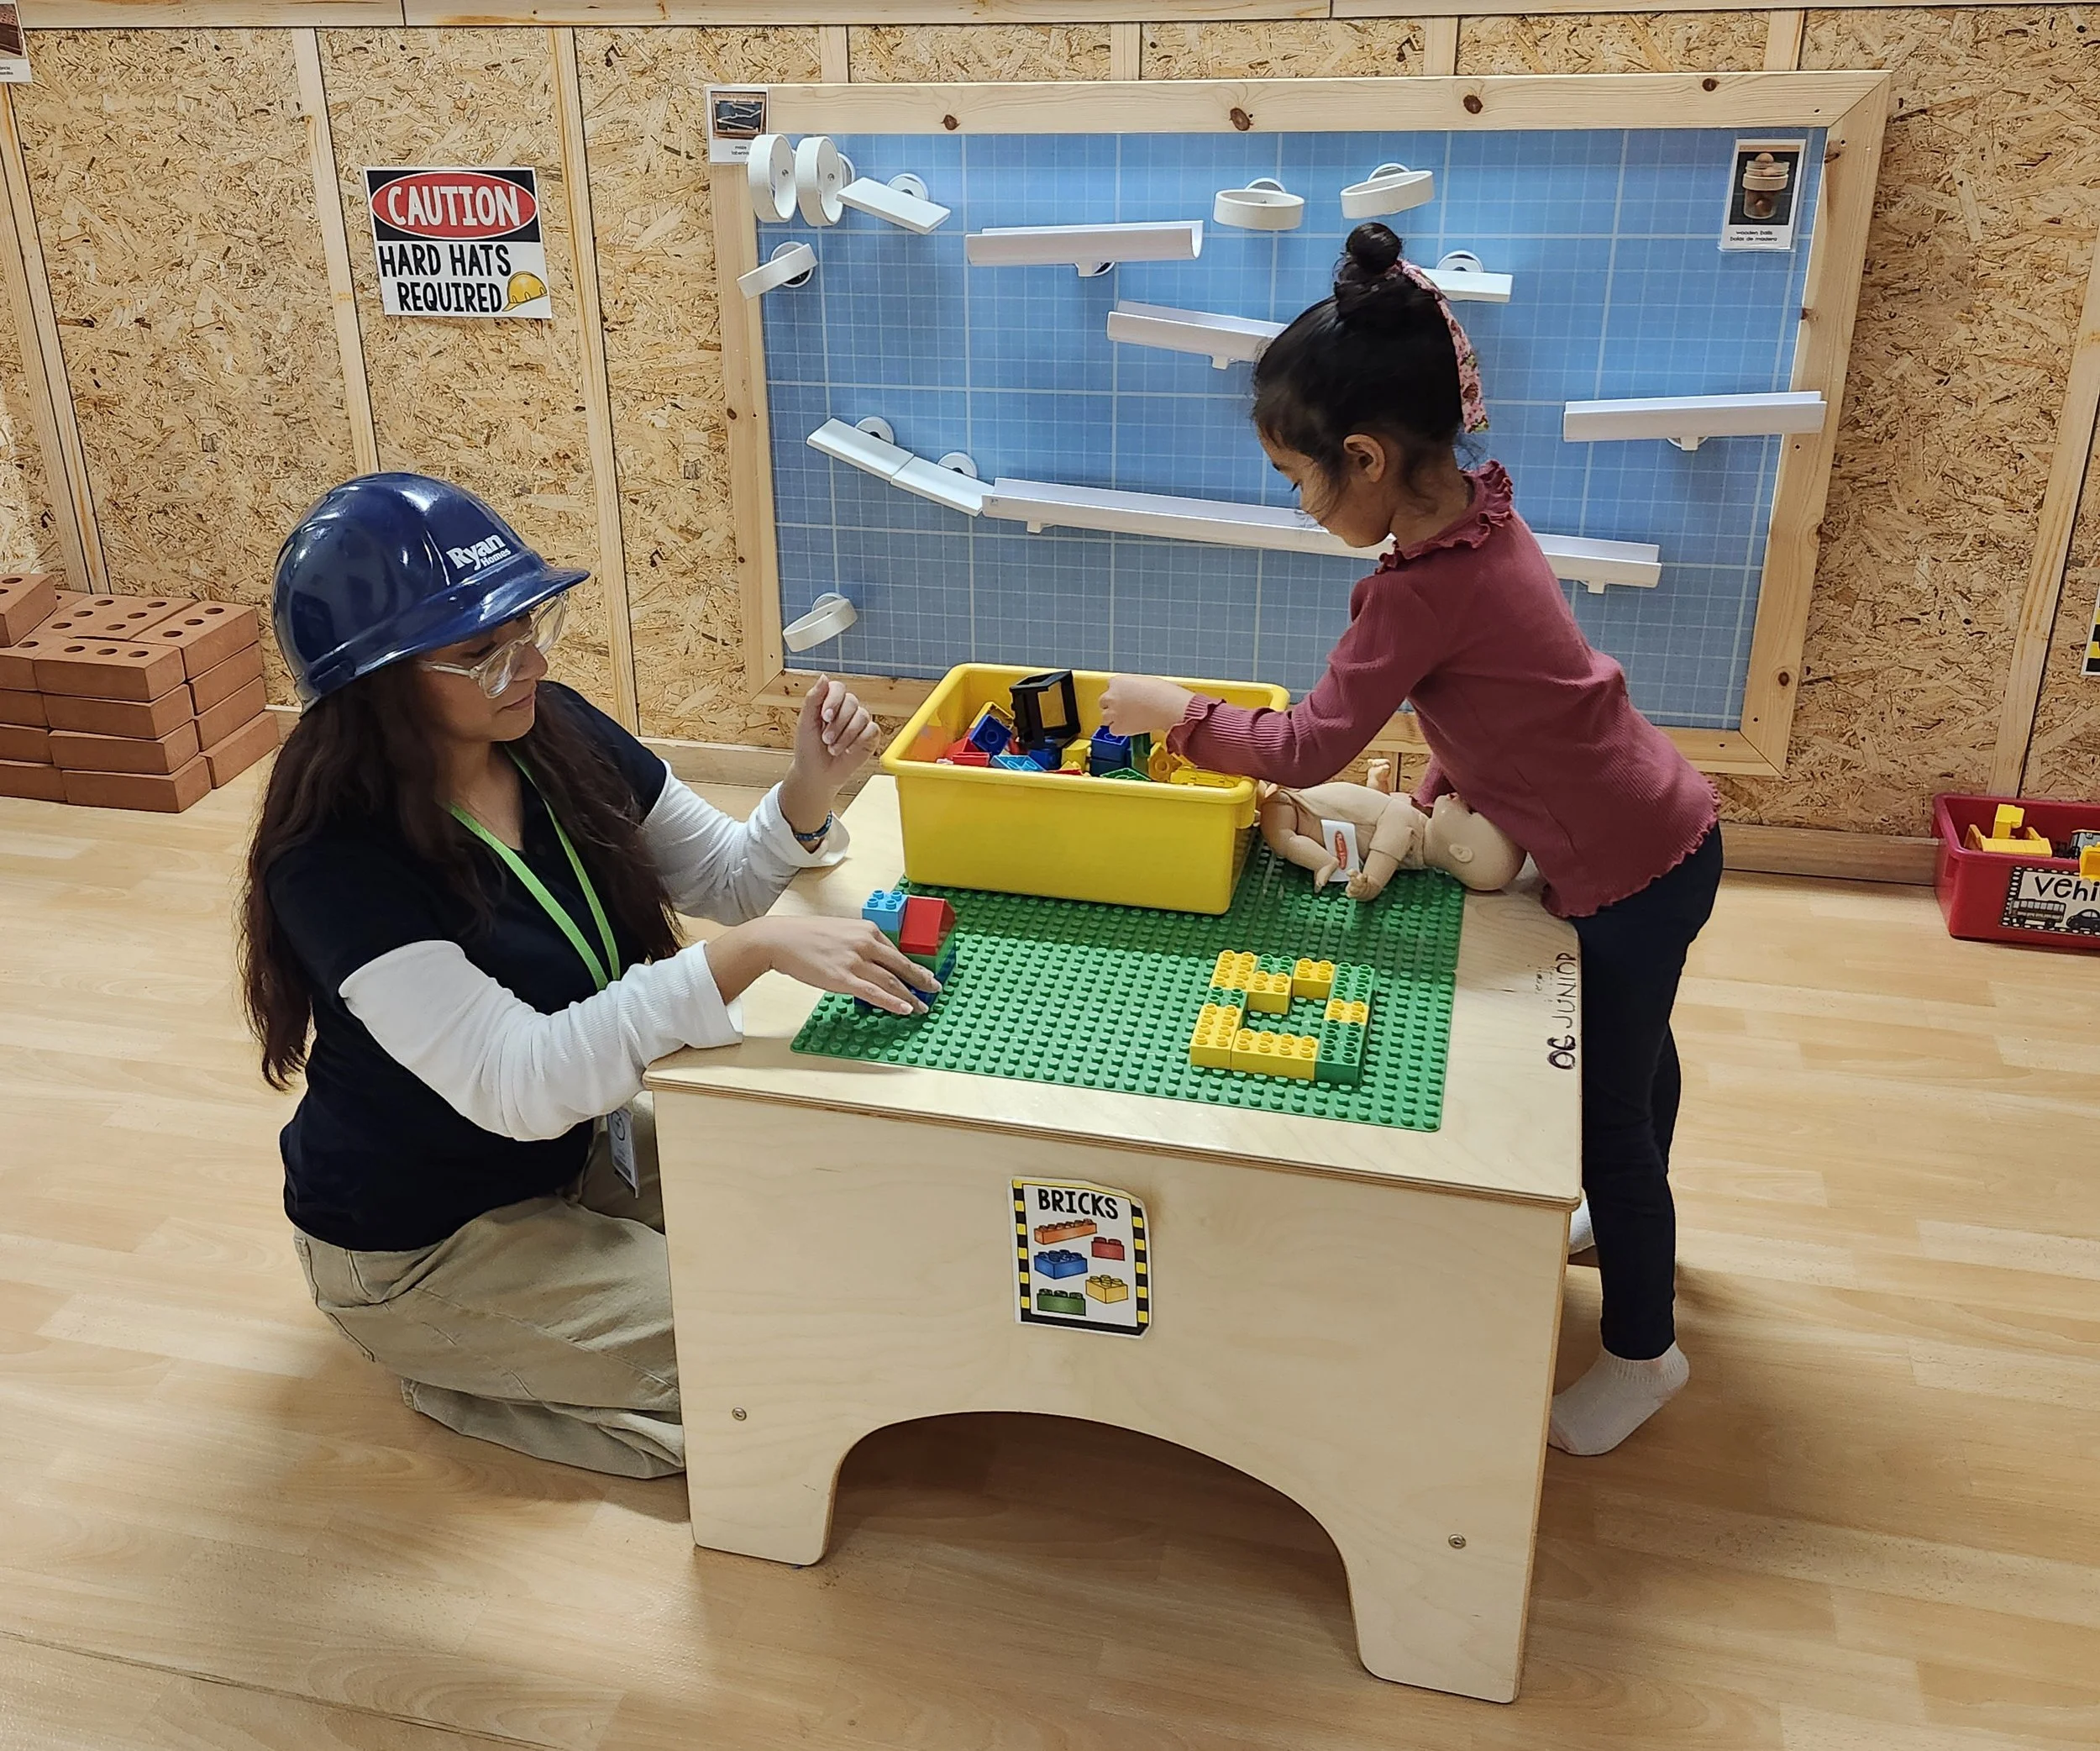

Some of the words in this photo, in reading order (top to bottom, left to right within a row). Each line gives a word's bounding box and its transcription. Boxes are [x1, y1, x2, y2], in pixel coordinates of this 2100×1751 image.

[387, 185, 521, 227] CAUTION
[378, 244, 442, 278] HARD
[449, 244, 512, 277] HATS
[396, 281, 502, 313] REQUIRED
[446, 534, 507, 571] Ryan
[480, 548, 512, 567] Homes
[2034, 876, 2100, 902] Vehi
[1037, 1188, 1119, 1220] BRICKS
